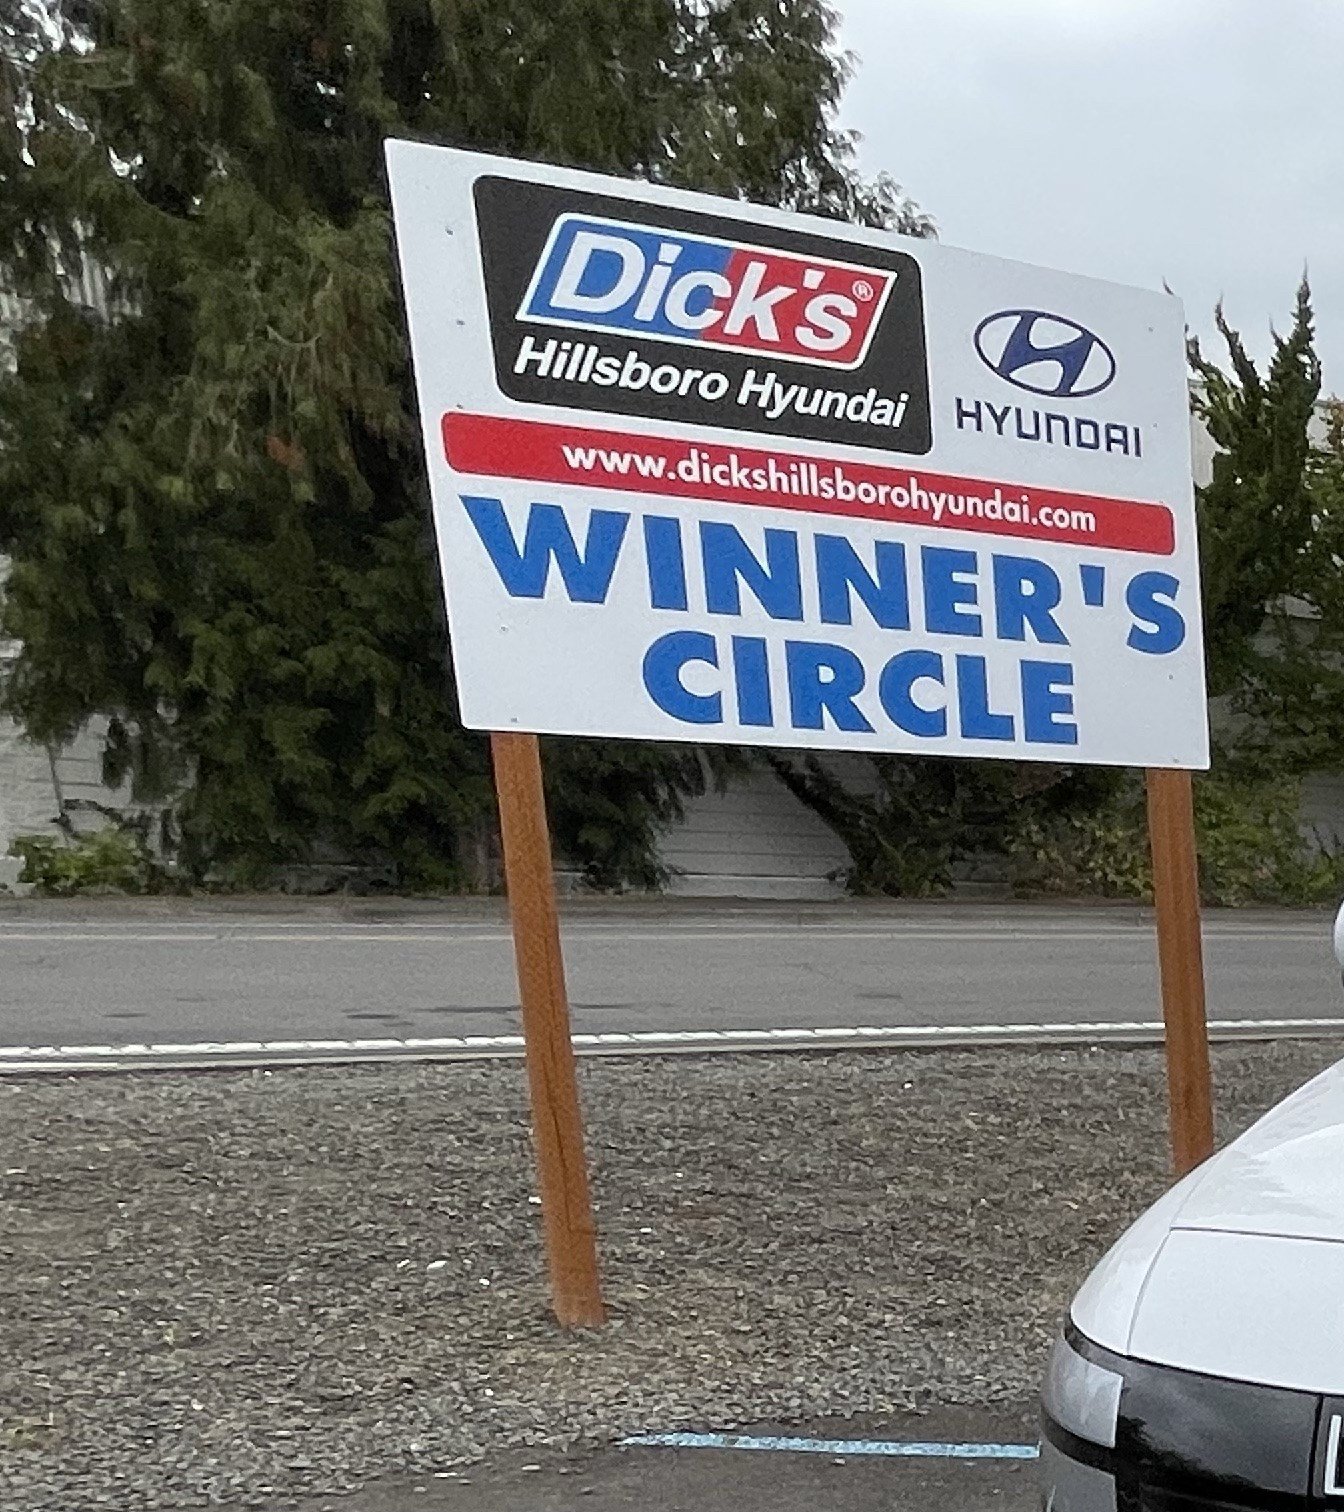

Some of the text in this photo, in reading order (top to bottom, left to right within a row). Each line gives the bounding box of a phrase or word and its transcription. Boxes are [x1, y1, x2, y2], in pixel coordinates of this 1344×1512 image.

[549, 230, 859, 352] Dick's
[513, 336, 908, 428] Hillsboro Hyundai
[956, 397, 1142, 458] HYUNDAI
[562, 443, 1096, 532] www.dickshillsborohyundai.com
[460, 494, 1185, 656] WINNER'S
[642, 630, 1078, 745] CIRCLE
